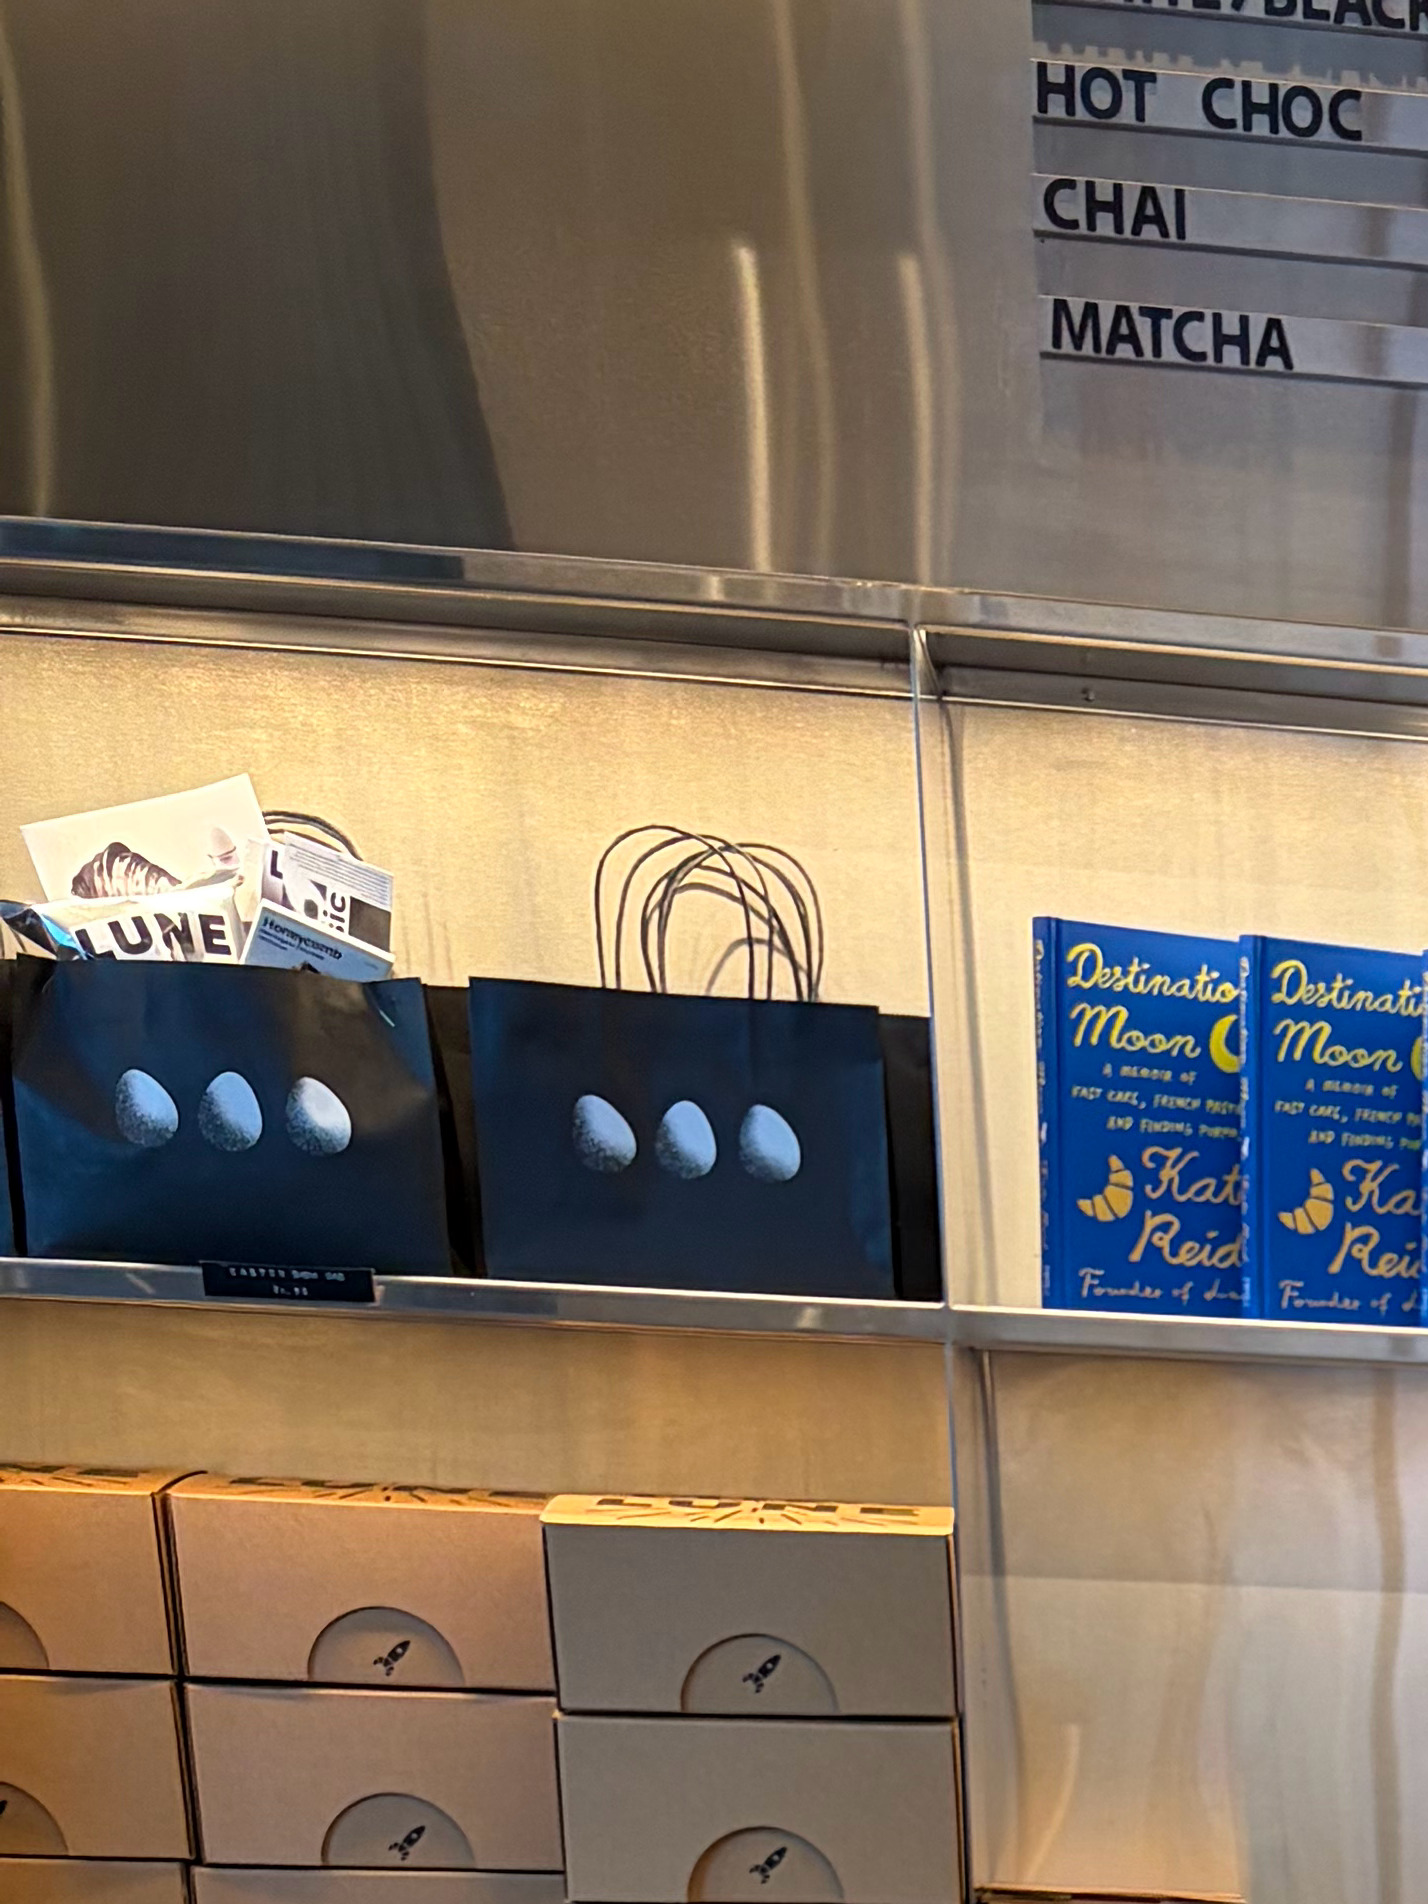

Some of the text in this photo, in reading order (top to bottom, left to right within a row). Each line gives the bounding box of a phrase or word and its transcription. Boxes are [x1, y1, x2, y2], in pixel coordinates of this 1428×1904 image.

[1036, 61, 1157, 122] HOT
[1203, 76, 1363, 142] CHOC
[1044, 177, 1188, 240] CHAI
[1050, 299, 1294, 371] MATCHA
[74, 911, 232, 961] LUNE
[1066, 943, 1240, 1003] Destinatio
[1270, 960, 1421, 1017] Destinati
[1070, 1003, 1201, 1058] Moon
[1274, 1018, 1403, 1073] Moon
[1142, 1146, 1240, 1206] Kat
[1342, 1159, 1423, 1217] Ka
